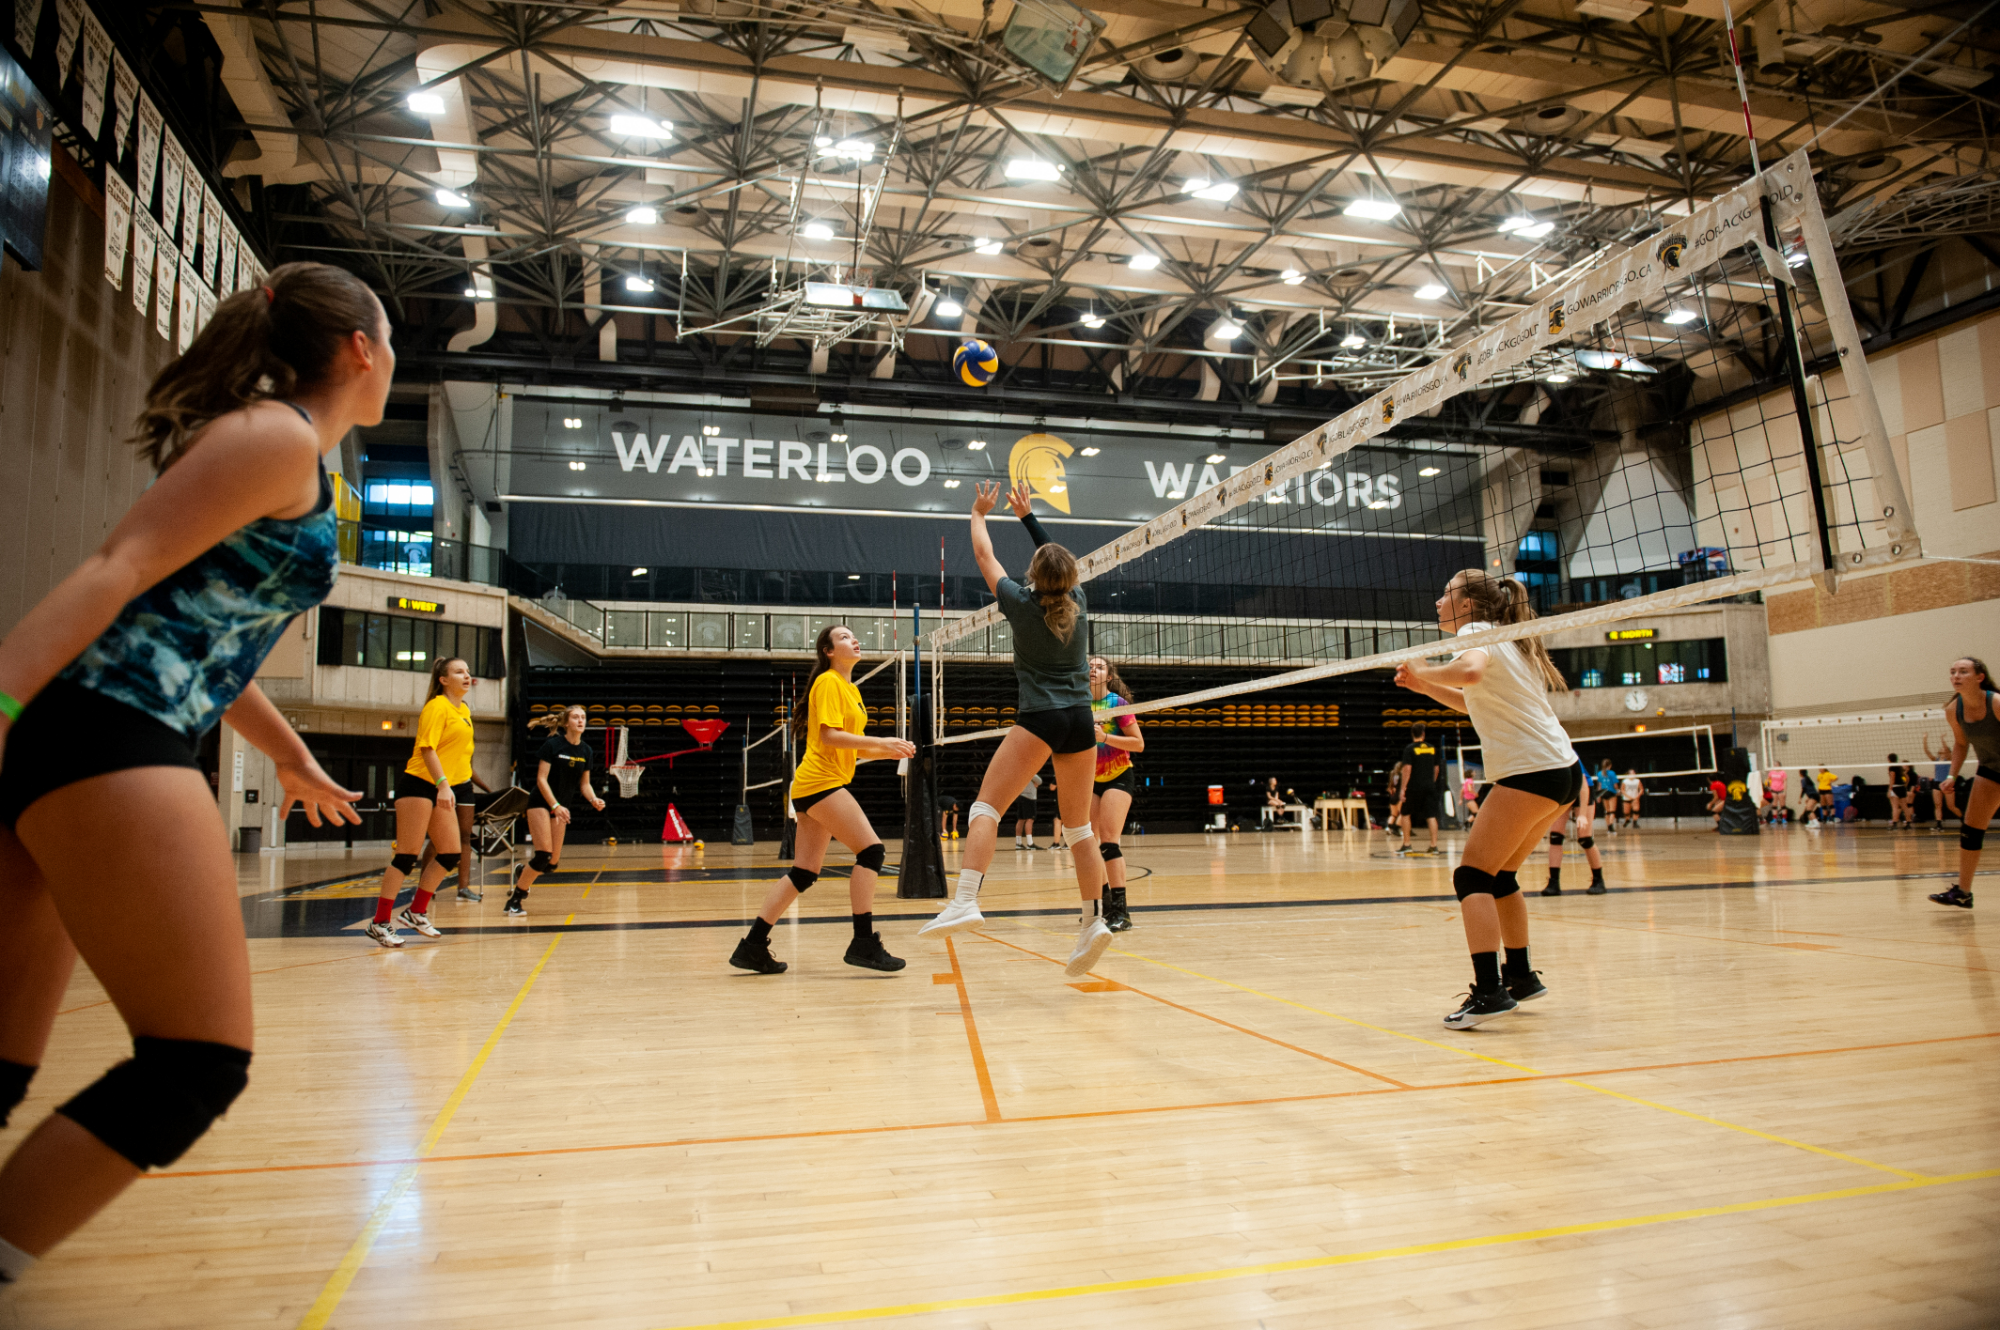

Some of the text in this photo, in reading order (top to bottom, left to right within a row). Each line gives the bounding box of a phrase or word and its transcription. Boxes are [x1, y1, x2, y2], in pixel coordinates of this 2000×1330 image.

[107, 184, 130, 215] CHAMPIONS
[110, 175, 129, 202] ONTARIO
[135, 212, 157, 244] CHAMPIONS
[138, 204, 155, 231] ONTARIO
[611, 431, 932, 487] WATERLOO
[1144, 460, 1402, 510] WARIORS
[411, 600, 438, 613] WEST
[1622, 629, 1653, 639] NORTH
